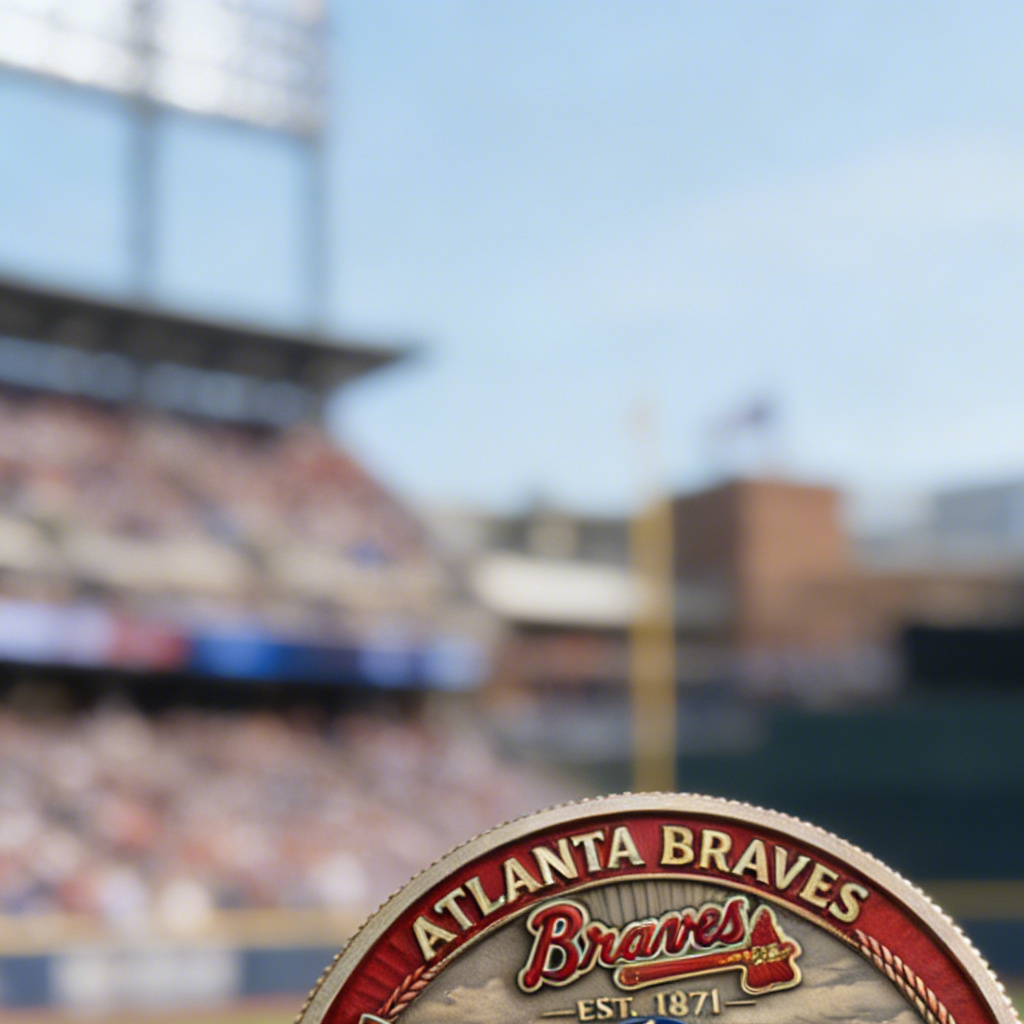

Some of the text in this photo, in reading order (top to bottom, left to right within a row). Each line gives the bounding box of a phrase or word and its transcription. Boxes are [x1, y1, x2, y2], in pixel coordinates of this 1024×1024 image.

[411, 825, 869, 962] ATLANTA BRAVES
[518, 896, 750, 993] Braves
[576, 988, 720, 1021] EST. 1871
